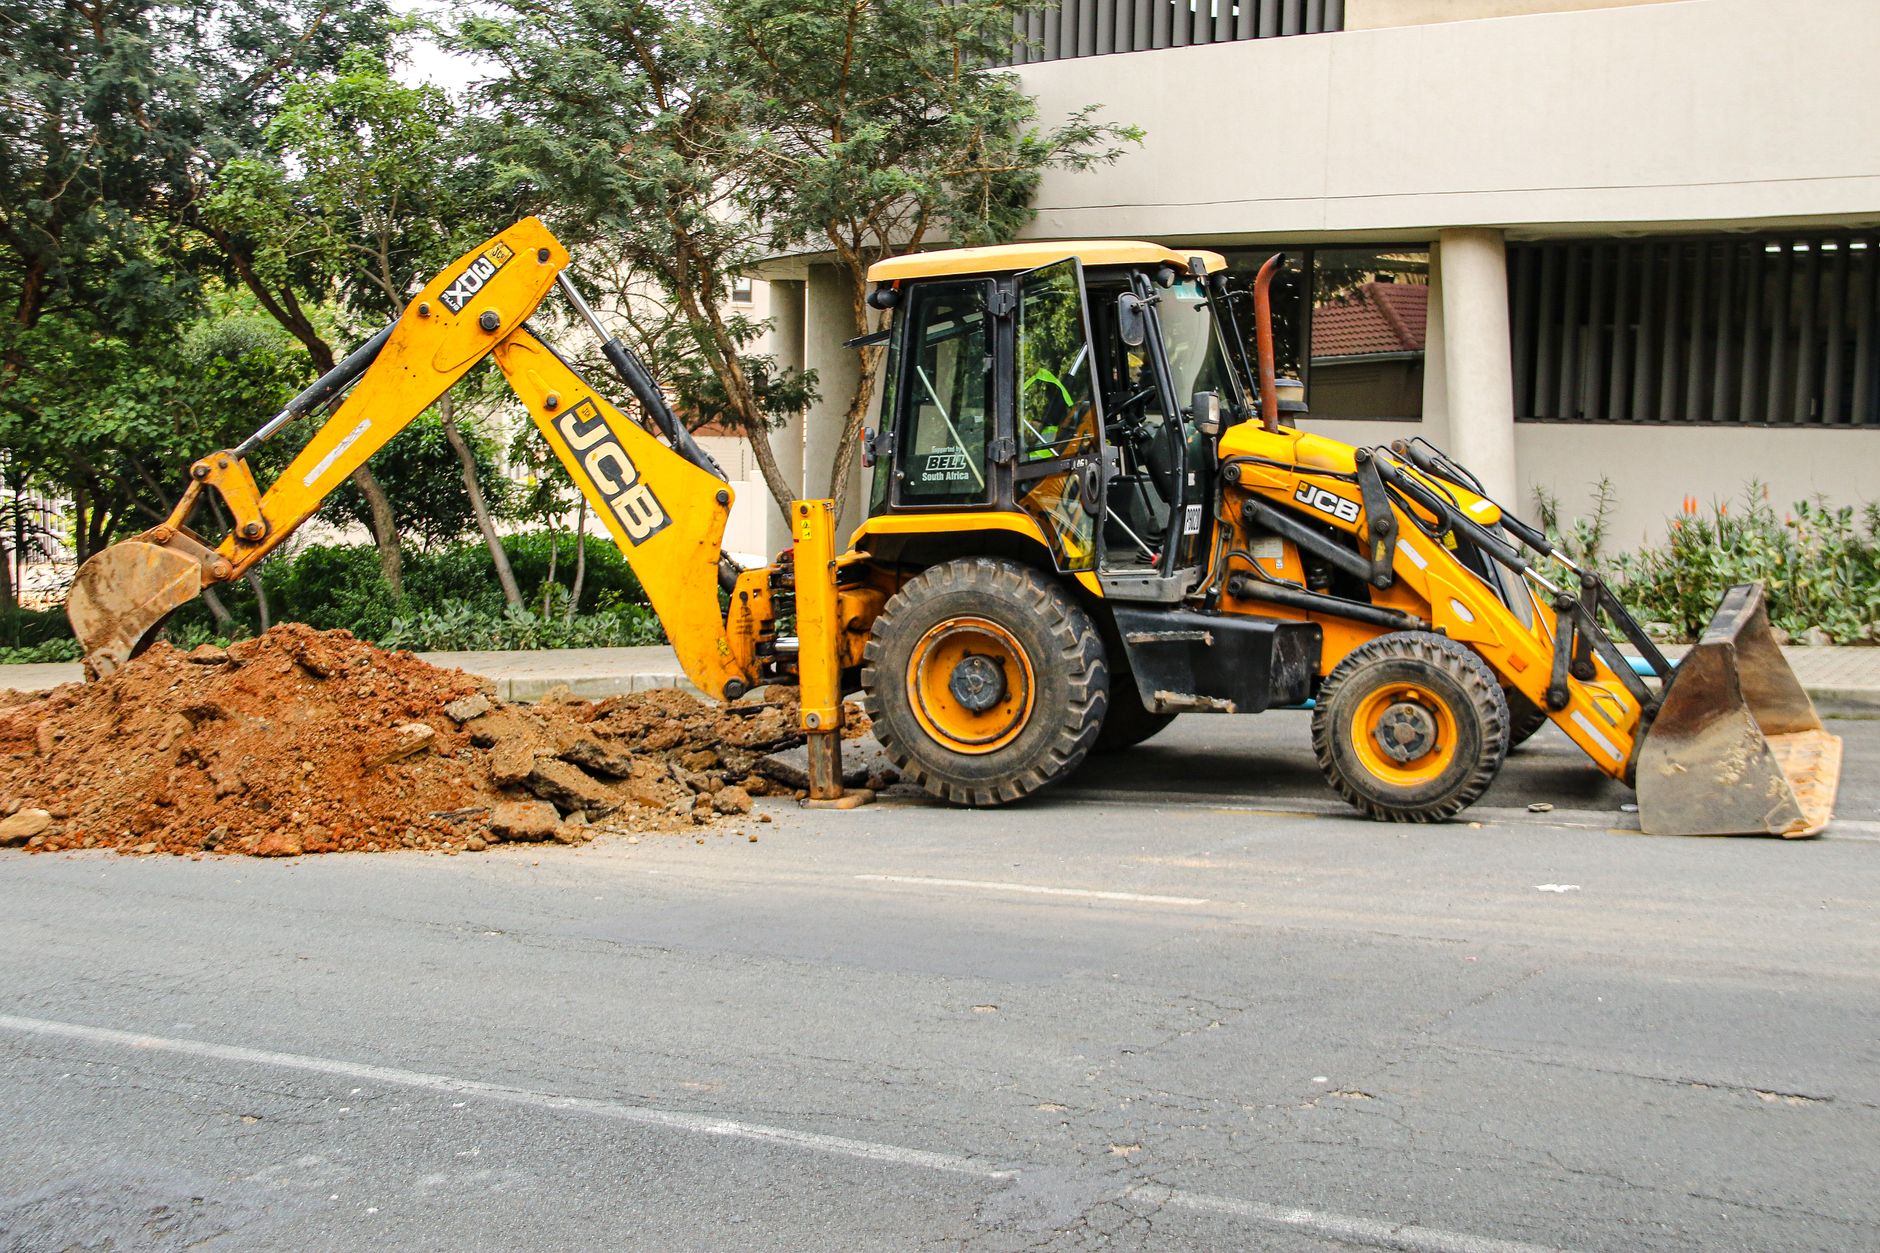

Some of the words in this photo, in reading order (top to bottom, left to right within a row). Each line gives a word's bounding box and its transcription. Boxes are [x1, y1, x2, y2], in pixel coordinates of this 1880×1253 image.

[926, 455, 966, 470] BELL
[559, 413, 664, 539] JCB
[922, 472, 944, 481] South
[946, 471, 969, 481] Africa
[1296, 486, 1360, 522] JCB
